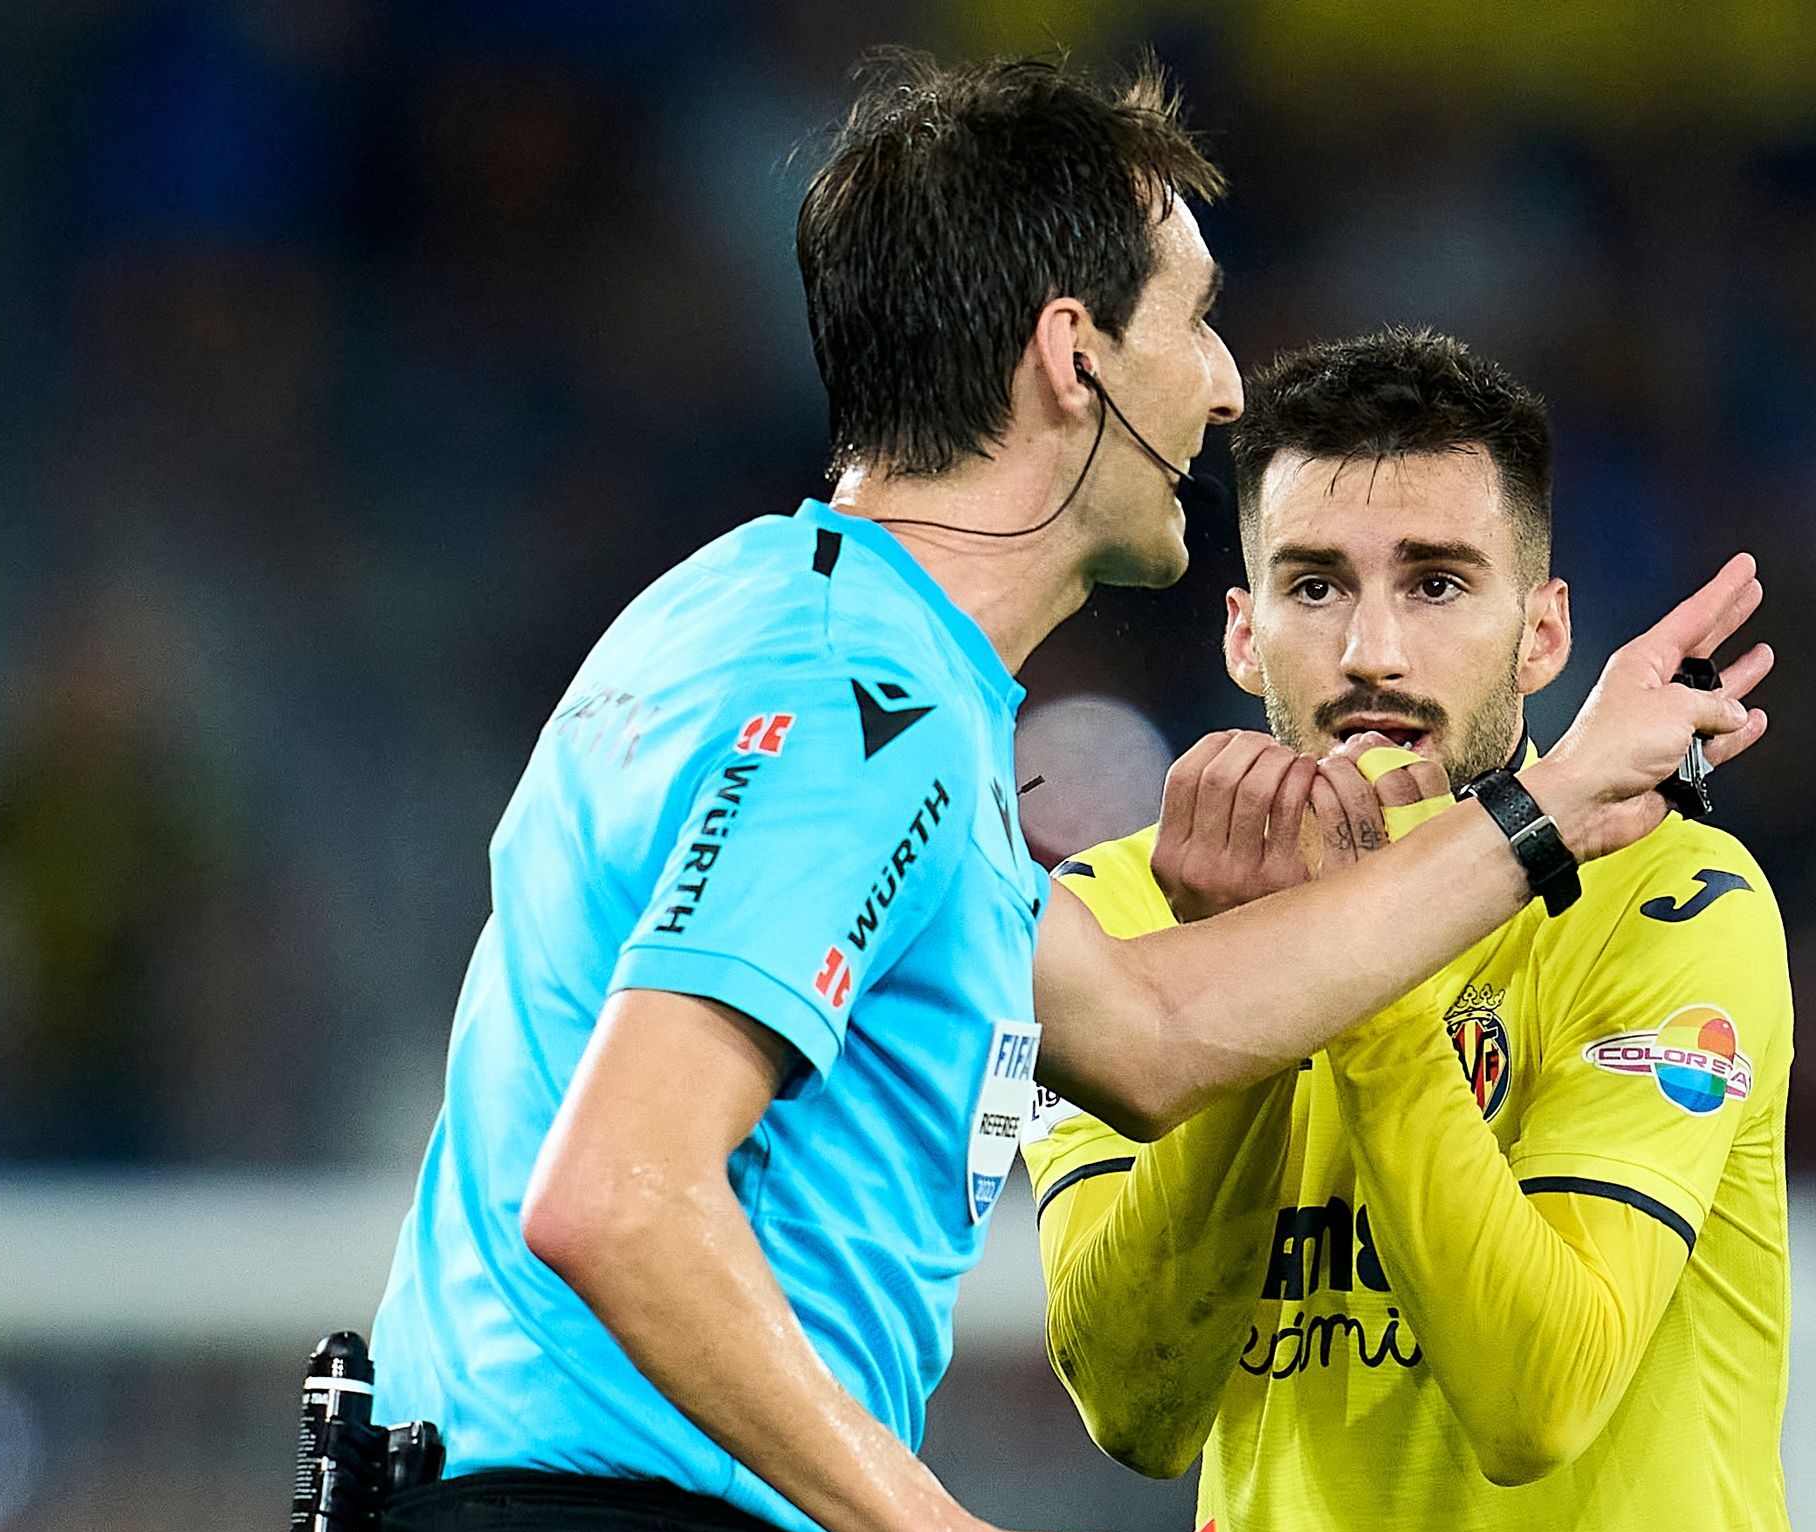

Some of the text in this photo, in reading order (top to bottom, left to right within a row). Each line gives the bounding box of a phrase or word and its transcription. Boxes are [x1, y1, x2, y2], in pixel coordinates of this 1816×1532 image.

[654, 764, 760, 935] WÜRTH
[847, 778, 951, 951] WÜRTH
[994, 1033, 1041, 1081] FIFA
[1598, 1047, 1708, 1068] COLOR
